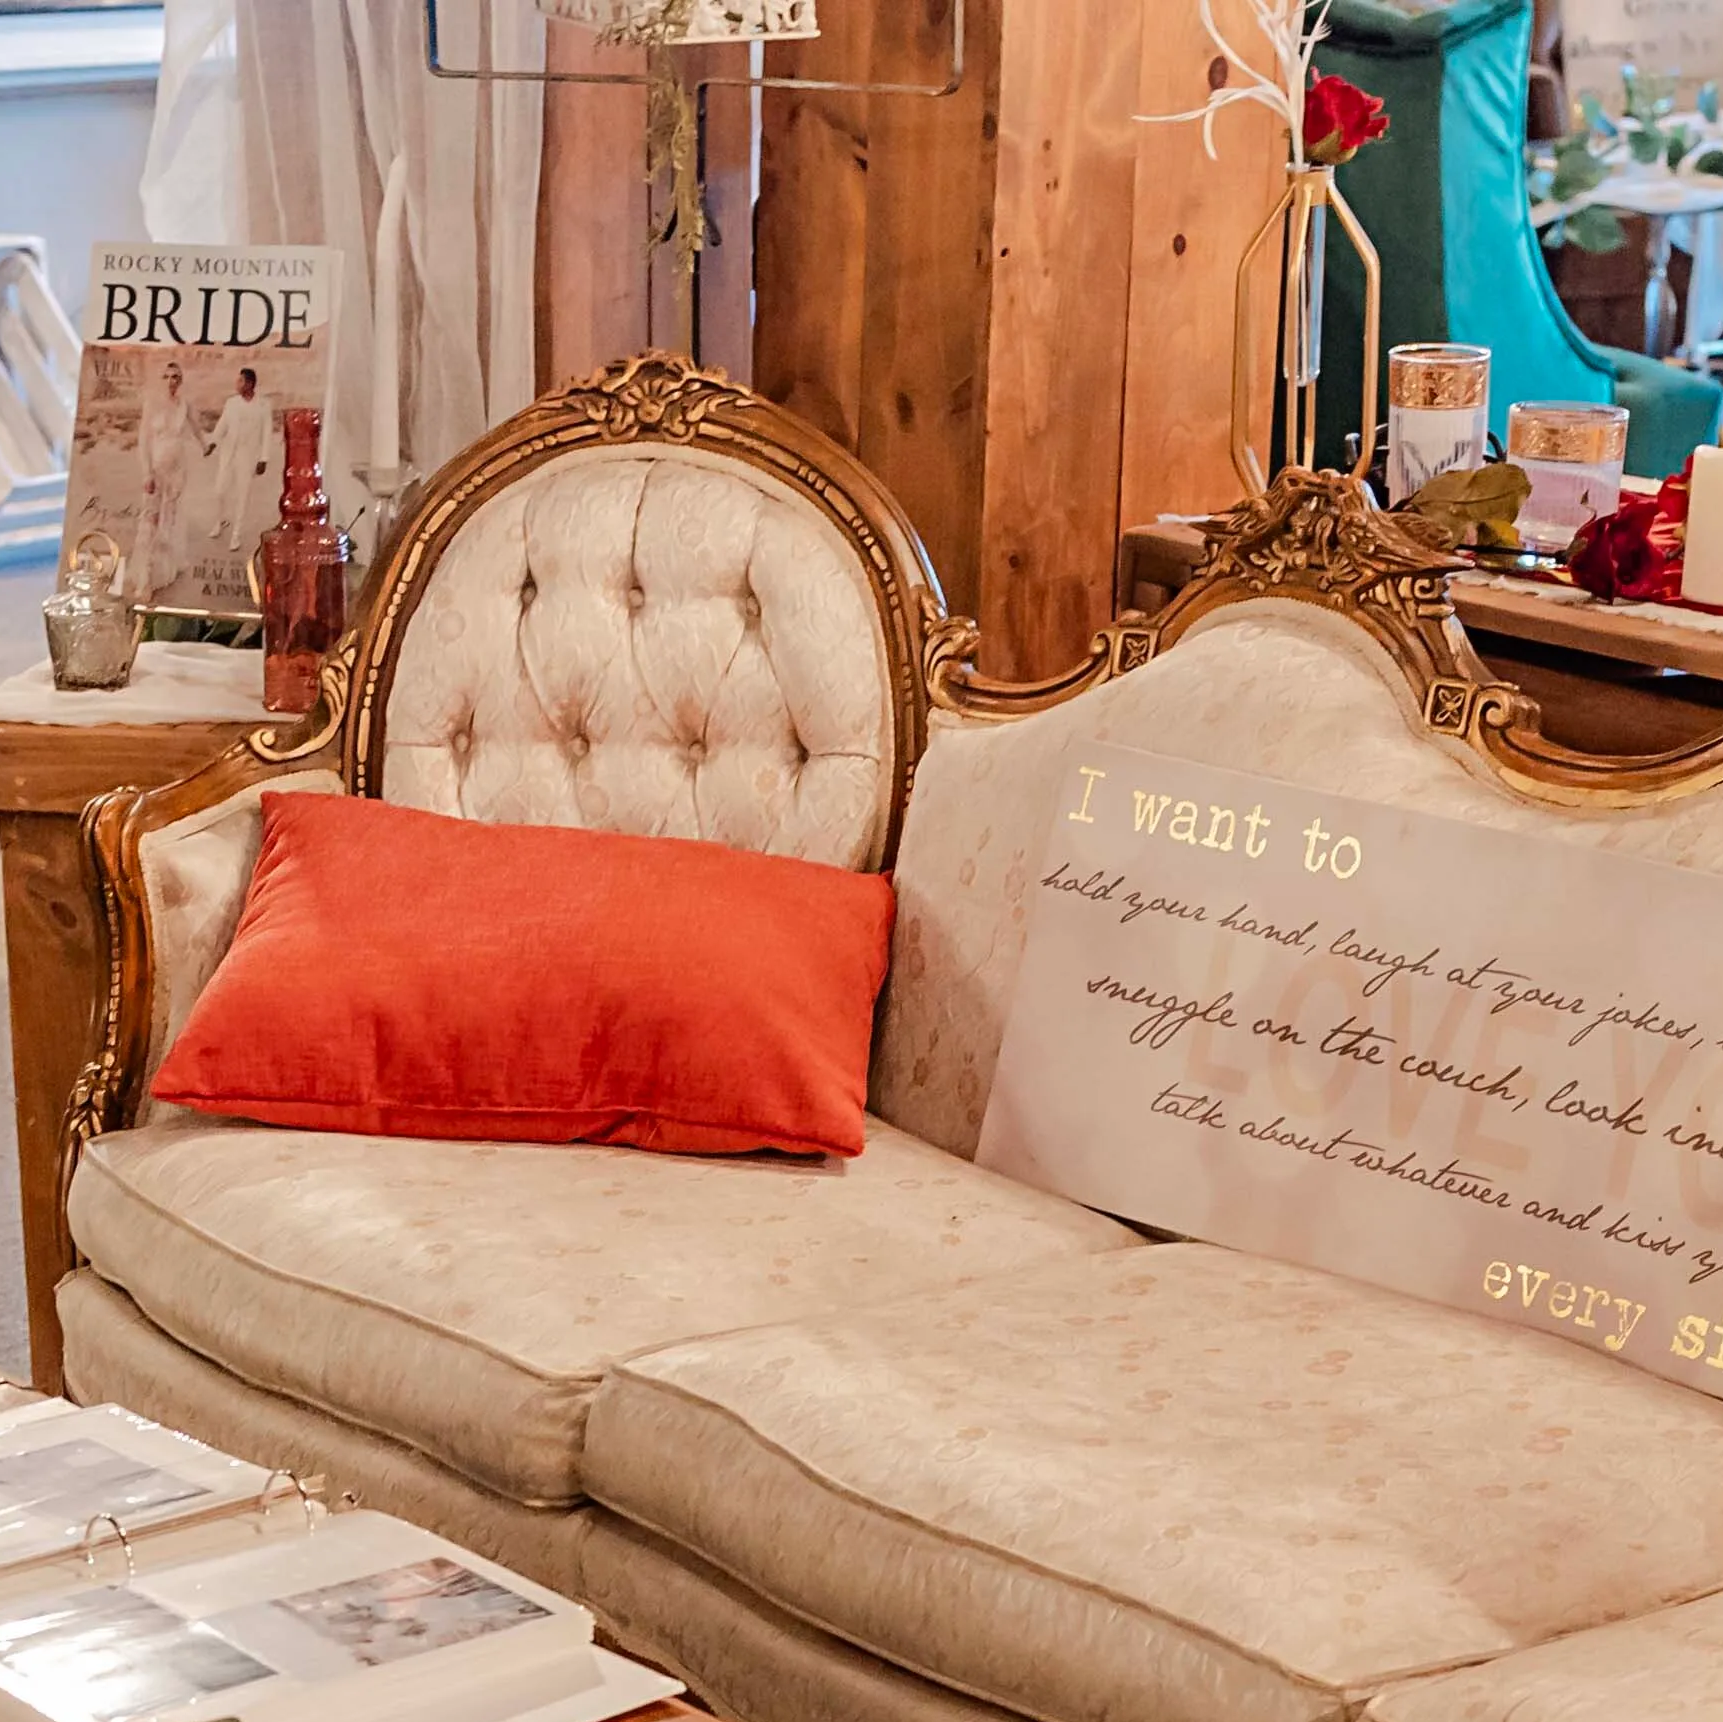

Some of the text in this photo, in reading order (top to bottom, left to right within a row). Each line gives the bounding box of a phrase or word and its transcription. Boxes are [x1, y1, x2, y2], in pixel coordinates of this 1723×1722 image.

[97, 283, 313, 349] BRIDE
[104, 254, 315, 278] ROCKY MOUNTAIN
[1068, 766, 1362, 879] I want to
[1041, 862, 1125, 901] hold
[1121, 885, 1208, 923] your
[1216, 904, 1318, 955] hand,
[1329, 929, 1440, 997] laugh
[1447, 957, 1531, 989] at
[1489, 979, 1586, 1015] your
[1568, 992, 1705, 1050] jokes,
[1087, 975, 1238, 1051] snuggle
[1252, 1016, 1307, 1045] on
[1320, 1016, 1396, 1068] the
[1399, 1053, 1529, 1112] couch,
[1545, 1080, 1648, 1135] look
[1150, 1082, 1226, 1129] talk
[1239, 1117, 1385, 1160] about
[1349, 1152, 1512, 1208] whatever
[1522, 1200, 1605, 1232] and
[1602, 1215, 1687, 1257] kiss
[1482, 1259, 1647, 1352] every
